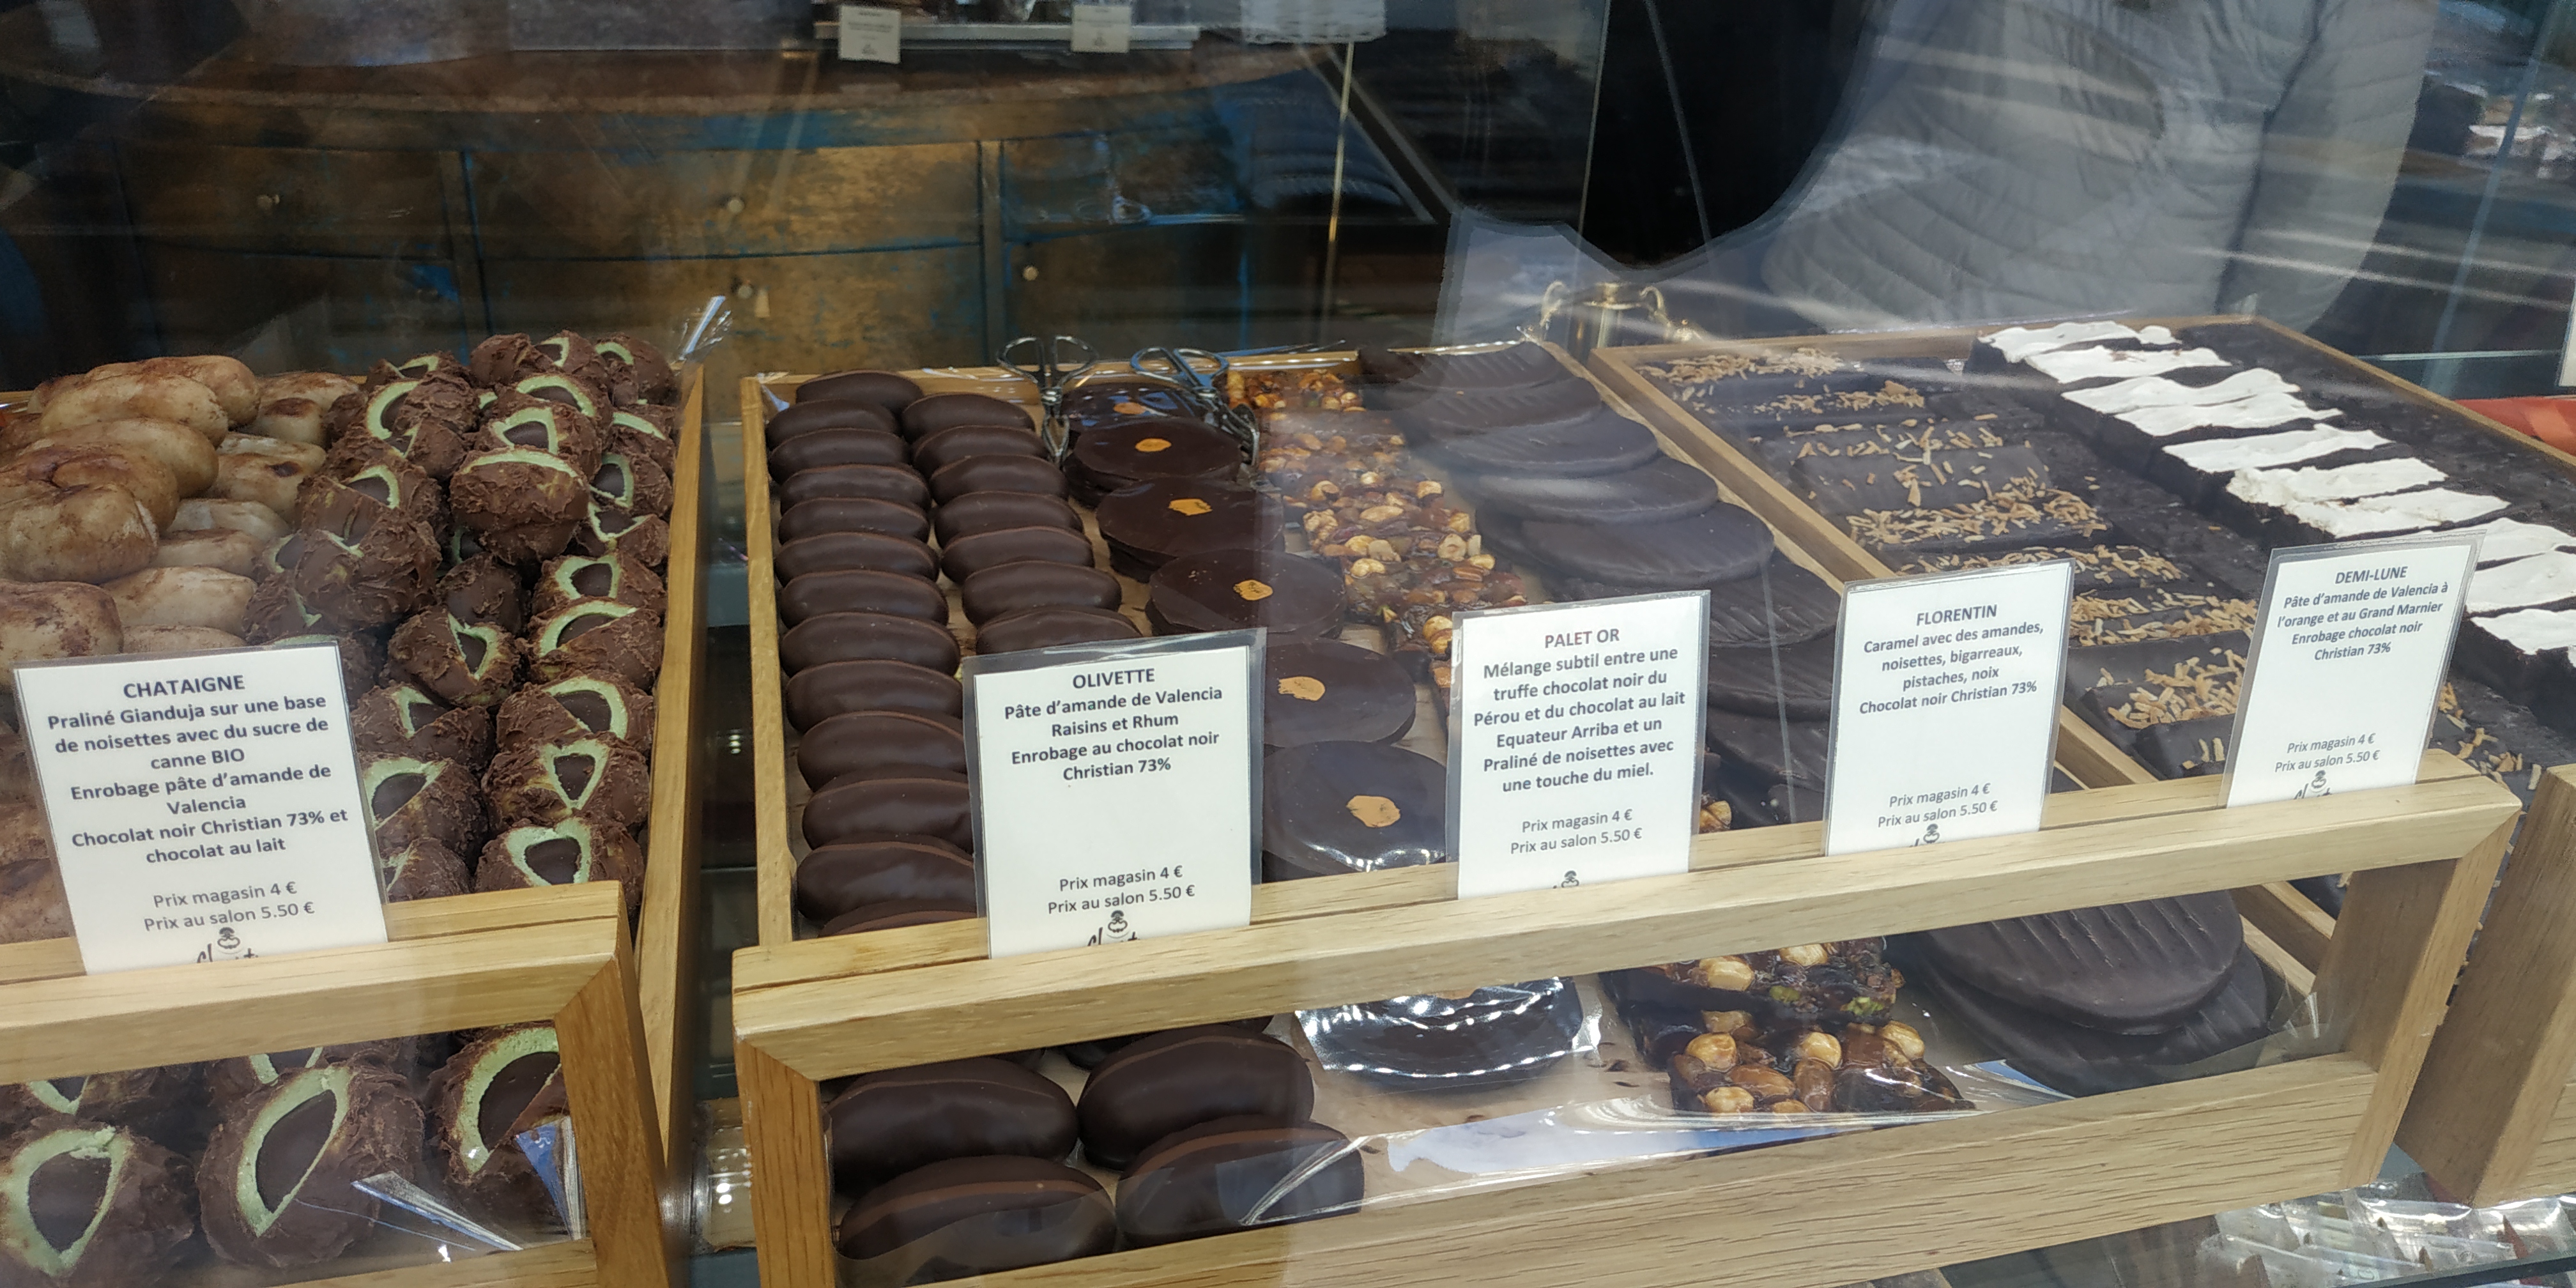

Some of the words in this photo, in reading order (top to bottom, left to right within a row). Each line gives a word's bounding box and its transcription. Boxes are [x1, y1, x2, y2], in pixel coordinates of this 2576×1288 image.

[2334, 565, 2409, 585] DEMI-LUNE
[2283, 595, 2310, 609] Pâte
[2312, 588, 2370, 606] d’amande
[2372, 587, 2388, 600] de
[2391, 583, 2439, 598] Valencia
[2441, 581, 2448, 594] à
[1916, 604, 1998, 627] FLORENTIN
[2277, 614, 2325, 628] l’orange
[2326, 611, 2340, 623] et
[2341, 611, 2357, 622] au
[2359, 604, 2395, 620] Grand
[2396, 601, 2444, 616] Marnier
[1544, 630, 1593, 649] PALET
[1596, 628, 1620, 643] OR
[1864, 634, 1919, 654] Caramel
[1922, 633, 1952, 647] avec
[1955, 629, 1979, 642] des
[1981, 621, 2044, 640] amandes,
[2291, 630, 2346, 645] Enrobage
[2348, 624, 2398, 639] chocolat
[2398, 620, 2423, 634] noir
[1483, 661, 1552, 679] Mélange
[1556, 652, 1599, 671] subtil
[1604, 651, 1646, 666] entre
[1650, 648, 1678, 662] une
[1882, 655, 1946, 672] noisettes,
[1950, 645, 2023, 664] bigarreaux,
[2314, 645, 2365, 661] Christian
[2367, 641, 2392, 655] 73%
[123, 674, 246, 699] CHATAIGNE
[1072, 668, 1155, 689] OLIVETTE
[1493, 683, 1538, 702] truffe
[1542, 676, 1609, 696] chocolat
[1613, 672, 1644, 689] noir
[1648, 670, 1667, 685] du
[1903, 671, 1968, 693] pistaches,
[1971, 666, 2000, 681] noix
[1004, 703, 1041, 720] Pâte
[1046, 694, 1127, 716] d’amande
[1131, 692, 1151, 707] de
[1154, 686, 1223, 704] Valencia
[1474, 710, 1520, 727] Pérou
[1524, 707, 1541, 721] et
[1544, 703, 1565, 719] du
[1568, 697, 1635, 716] chocolat
[1638, 697, 1657, 709] au
[1661, 691, 1686, 707] lait
[1859, 696, 1918, 714] Chocolat
[1921, 692, 1948, 707] noir
[1951, 686, 2007, 703] Christian
[2011, 680, 2037, 695] 73%
[47, 710, 116, 730] Praliné
[119, 703, 206, 724] Gianduja
[210, 703, 239, 717] sur
[243, 700, 279, 714] une
[283, 695, 326, 710] base
[1052, 719, 1108, 737] Raisins
[1112, 717, 1128, 731] et
[1132, 714, 1179, 729] Rhum
[54, 738, 79, 754] de
[84, 733, 172, 751] noisettes
[176, 729, 219, 744] avec
[224, 724, 248, 739] du
[252, 722, 302, 737] sucre
[305, 717, 329, 732] de
[1496, 729, 1568, 749] Equateur
[1570, 721, 1619, 740] Arriba
[1623, 720, 1639, 733] et
[1643, 719, 1662, 732] un
[2287, 741, 2309, 754] Prix
[2310, 735, 2356, 751] magasin
[2357, 733, 2366, 745] 4
[2367, 732, 2376, 744] €
[150, 755, 207, 770] canne
[211, 747, 245, 764] BIO
[1011, 746, 1088, 765] Enrobage
[1092, 744, 1112, 756] au
[1116, 734, 1184, 753] chocolat
[1188, 731, 1220, 746] noir
[1483, 752, 1538, 772] Praliné
[1542, 750, 1561, 765] de
[1565, 745, 1636, 763] noisettes
[1639, 740, 1674, 755] avec
[2274, 760, 2296, 773] Prix
[2297, 760, 2312, 770] au
[2313, 755, 2343, 769] salon
[2345, 751, 2371, 764] 5.50
[2372, 749, 2380, 761] €
[70, 782, 160, 801] Enrobage
[165, 776, 207, 795] pâte
[211, 766, 304, 788] d’amande
[309, 763, 332, 779] de
[1062, 762, 1133, 781] Christian
[1137, 756, 1172, 773] 73%
[1503, 779, 1532, 792] une
[1535, 770, 1589, 788] touche
[1593, 767, 1613, 782] du
[1617, 762, 1654, 779] miel.
[165, 795, 247, 815] Valencia
[1889, 793, 1914, 808] Prix
[1916, 786, 1968, 804] magasin
[1970, 784, 1979, 796] 4
[1982, 782, 1991, 795] €
[1522, 819, 1548, 833] Prix
[1552, 812, 1608, 830] magasin
[1611, 810, 1621, 822] 4
[1623, 808, 1633, 821] €
[1878, 814, 1902, 828] Prix
[1905, 813, 1920, 824] au
[1922, 808, 1956, 822] salon
[1959, 802, 1987, 816] 5.50
[1989, 800, 1998, 812] €
[72, 827, 155, 847] Chocolat
[159, 823, 196, 839] noir
[201, 816, 282, 835] Christian
[286, 810, 325, 827] 73%
[329, 809, 349, 823] et
[1510, 840, 1537, 855] Prix
[1540, 840, 1557, 851] au
[1560, 834, 1597, 848] salon
[1600, 829, 1630, 844] 5.50
[1633, 827, 1643, 839] €
[146, 844, 226, 864] chocolat
[229, 843, 252, 855] au
[256, 837, 287, 853] lait
[1059, 877, 1089, 892] Prix
[1092, 868, 1156, 888] magasin
[1160, 866, 1170, 879] 4
[1173, 864, 1183, 878] €
[153, 893, 188, 908] Prix
[192, 885, 266, 905] magasin
[270, 883, 282, 896] 4
[285, 881, 298, 894] €
[1048, 900, 1077, 915] Prix
[1081, 898, 1100, 910] au
[1104, 892, 1144, 908] salon
[1149, 885, 1182, 902] 5.50
[1185, 884, 1195, 897] €
[144, 916, 180, 931] Prix
[183, 916, 205, 928] au
[209, 909, 256, 924] salon
[261, 903, 299, 919] 5.50
[303, 901, 315, 914] €
